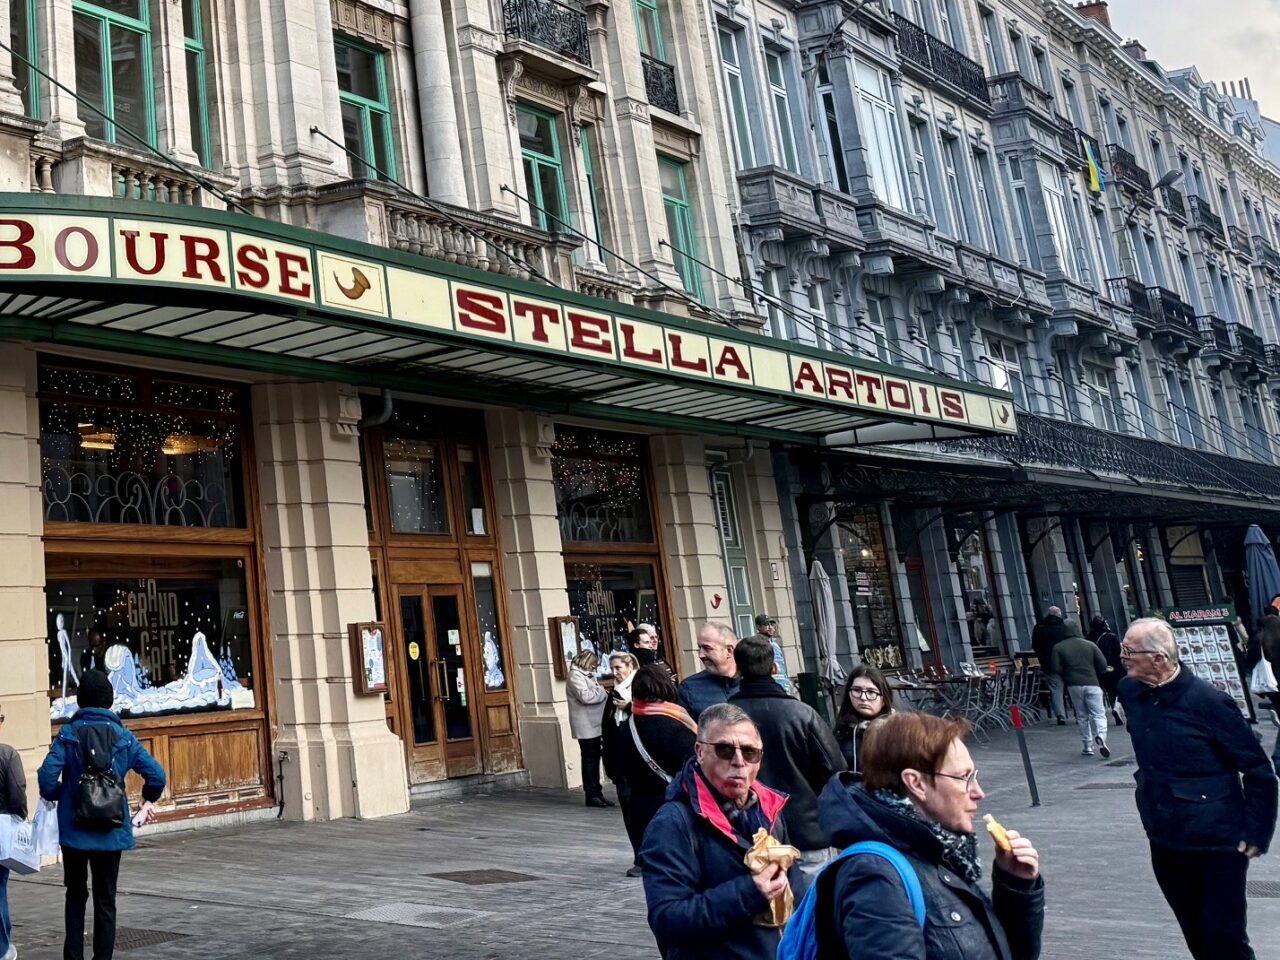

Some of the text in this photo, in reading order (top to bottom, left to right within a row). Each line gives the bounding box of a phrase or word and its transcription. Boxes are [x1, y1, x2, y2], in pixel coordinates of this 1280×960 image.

[456, 289, 964, 419] STELLA ARTOIS
[128, 579, 179, 628] GRAND
